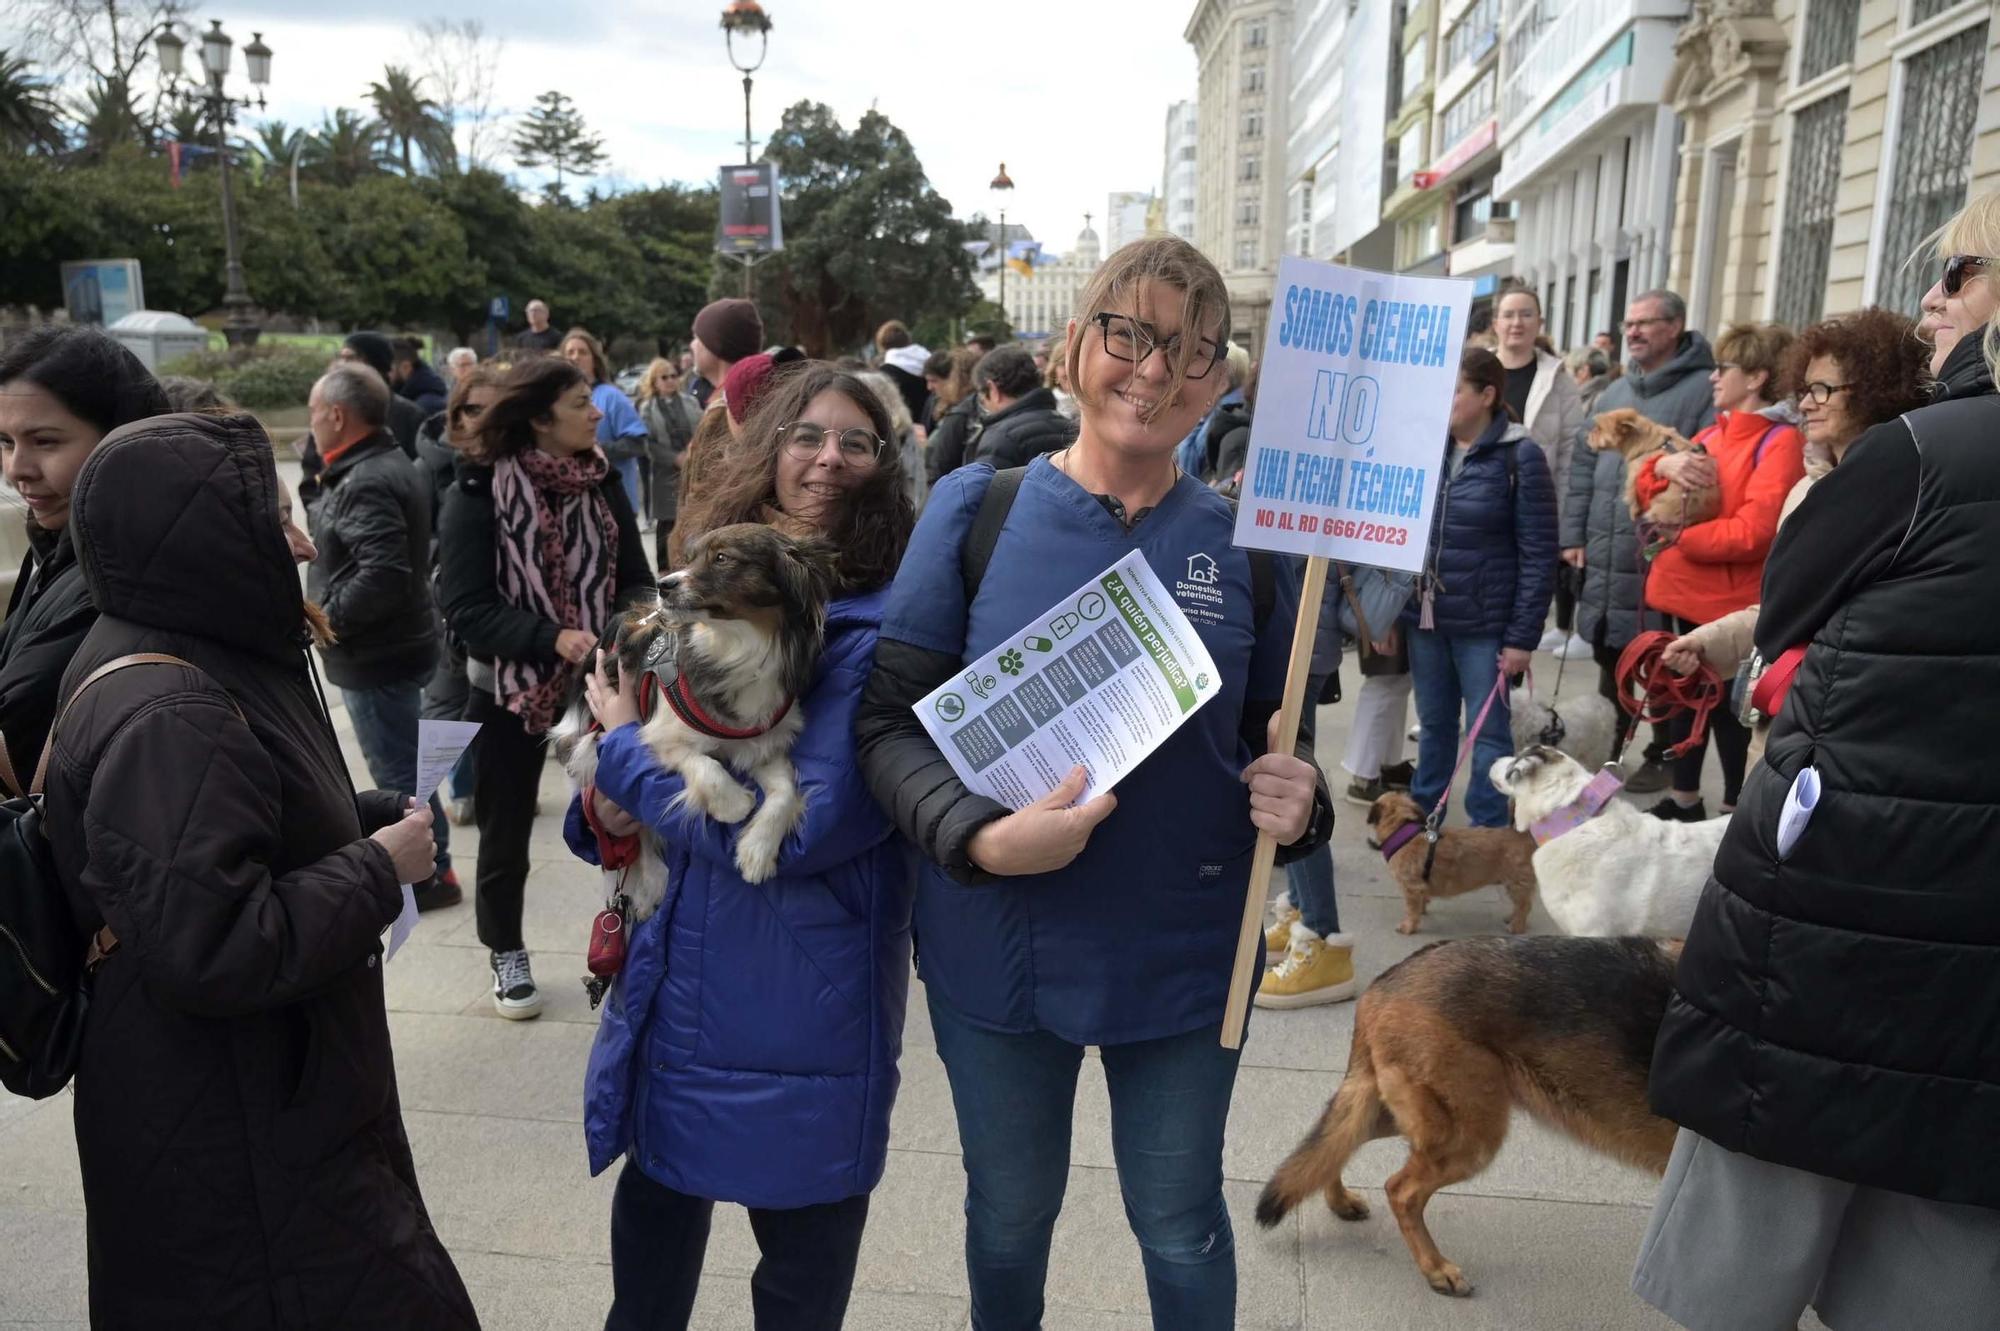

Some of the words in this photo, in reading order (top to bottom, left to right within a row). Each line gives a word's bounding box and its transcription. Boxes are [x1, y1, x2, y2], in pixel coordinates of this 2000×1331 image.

[1280, 285, 1357, 357] SOMOS
[1359, 299, 1452, 368] CIENCIA
[1307, 369, 1379, 445] NO
[1253, 447, 1290, 500] UNA
[1291, 453, 1343, 508] FICHA
[1346, 448, 1426, 520] TÉCNICA
[1255, 509, 1274, 528] NO
[1278, 512, 1294, 531] AL
[1298, 515, 1318, 533] RD
[1323, 517, 1408, 546] 666/2023
[1126, 566, 1148, 596] NORMATIVA
[1145, 596, 1175, 635] MEDICAMENTOS
[1175, 590, 1223, 604] veterinaria
[1176, 581, 1222, 596] Domestika
[1180, 607, 1199, 615] arisa
[1200, 609, 1224, 620] Herrero
[1105, 577, 1126, 596] ¿A
[1117, 595, 1150, 632] quién
[1142, 630, 1188, 690] perjudica?
